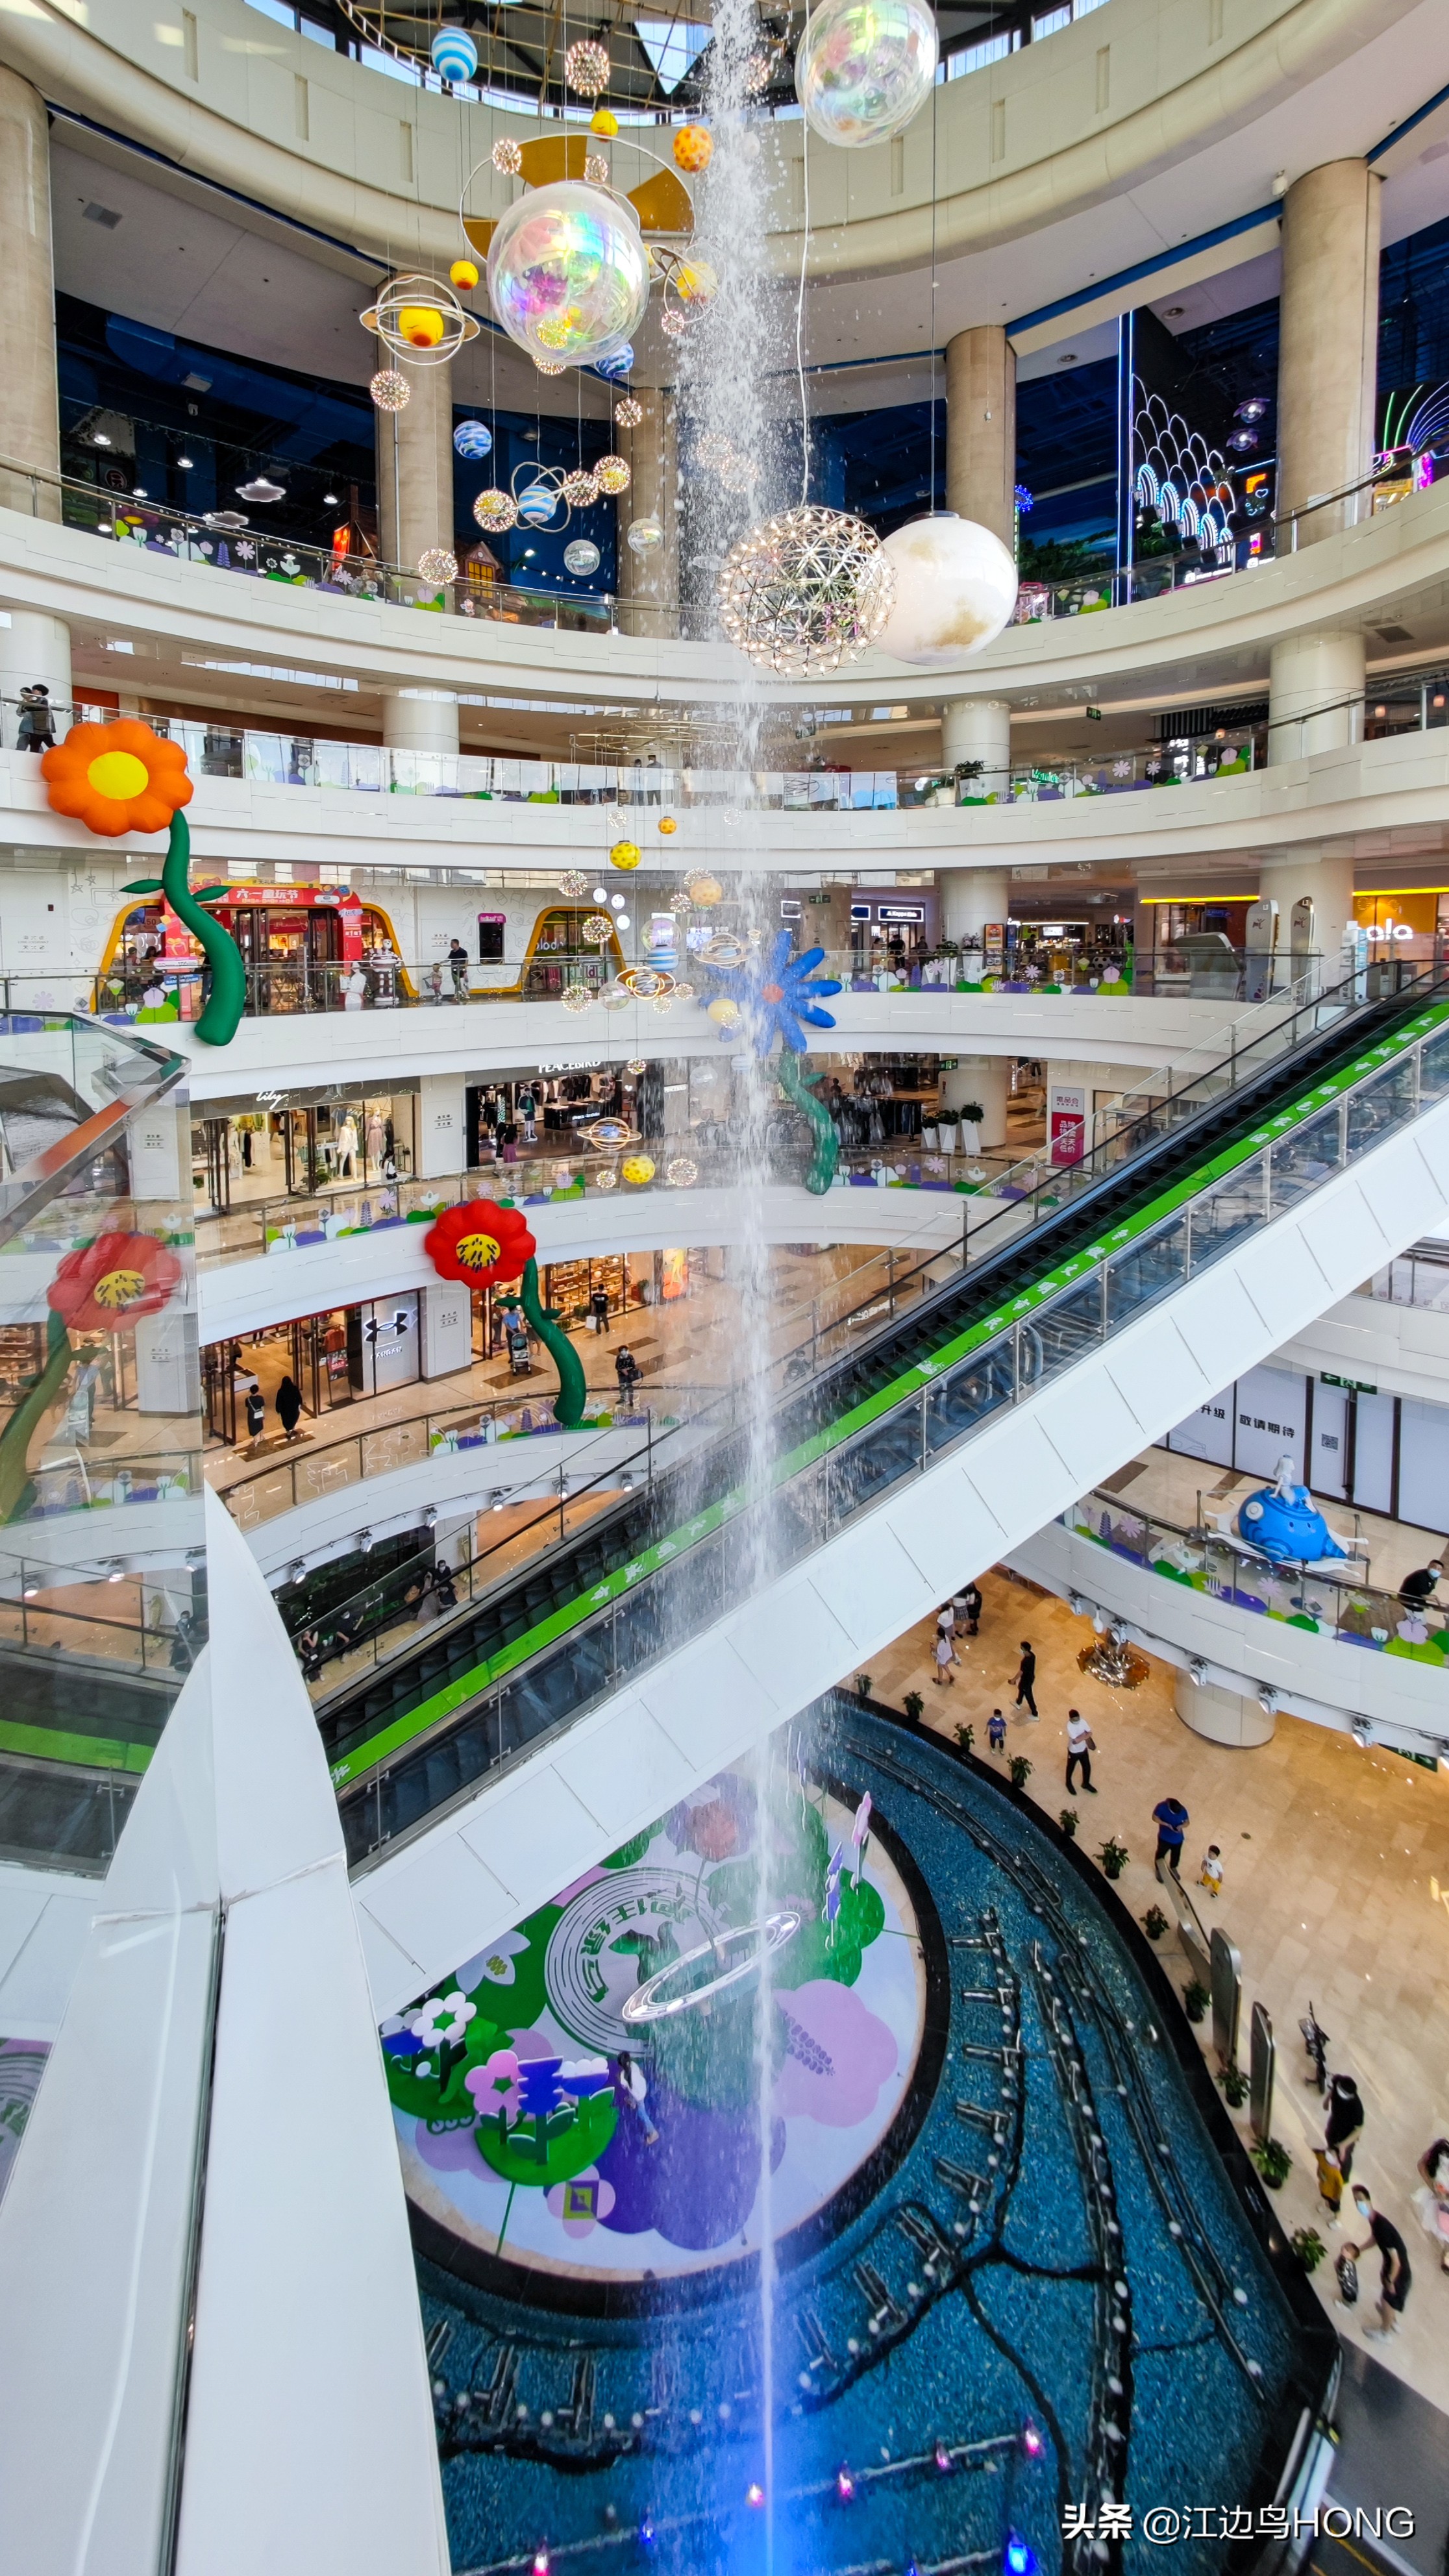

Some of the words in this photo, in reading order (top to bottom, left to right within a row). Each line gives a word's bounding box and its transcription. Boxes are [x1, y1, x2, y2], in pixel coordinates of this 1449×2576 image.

[236, 888, 298, 899] 六一童玩节
[1357, 918, 1413, 941] ala
[1355, 1017, 1433, 1071] 文明城市
[538, 1061, 601, 1074] PEACEBIRD
[1249, 1085, 1338, 1143] 绿色家园
[1196, 1405, 1226, 1420] 升级
[1239, 1414, 1295, 1439] 敬请期待
